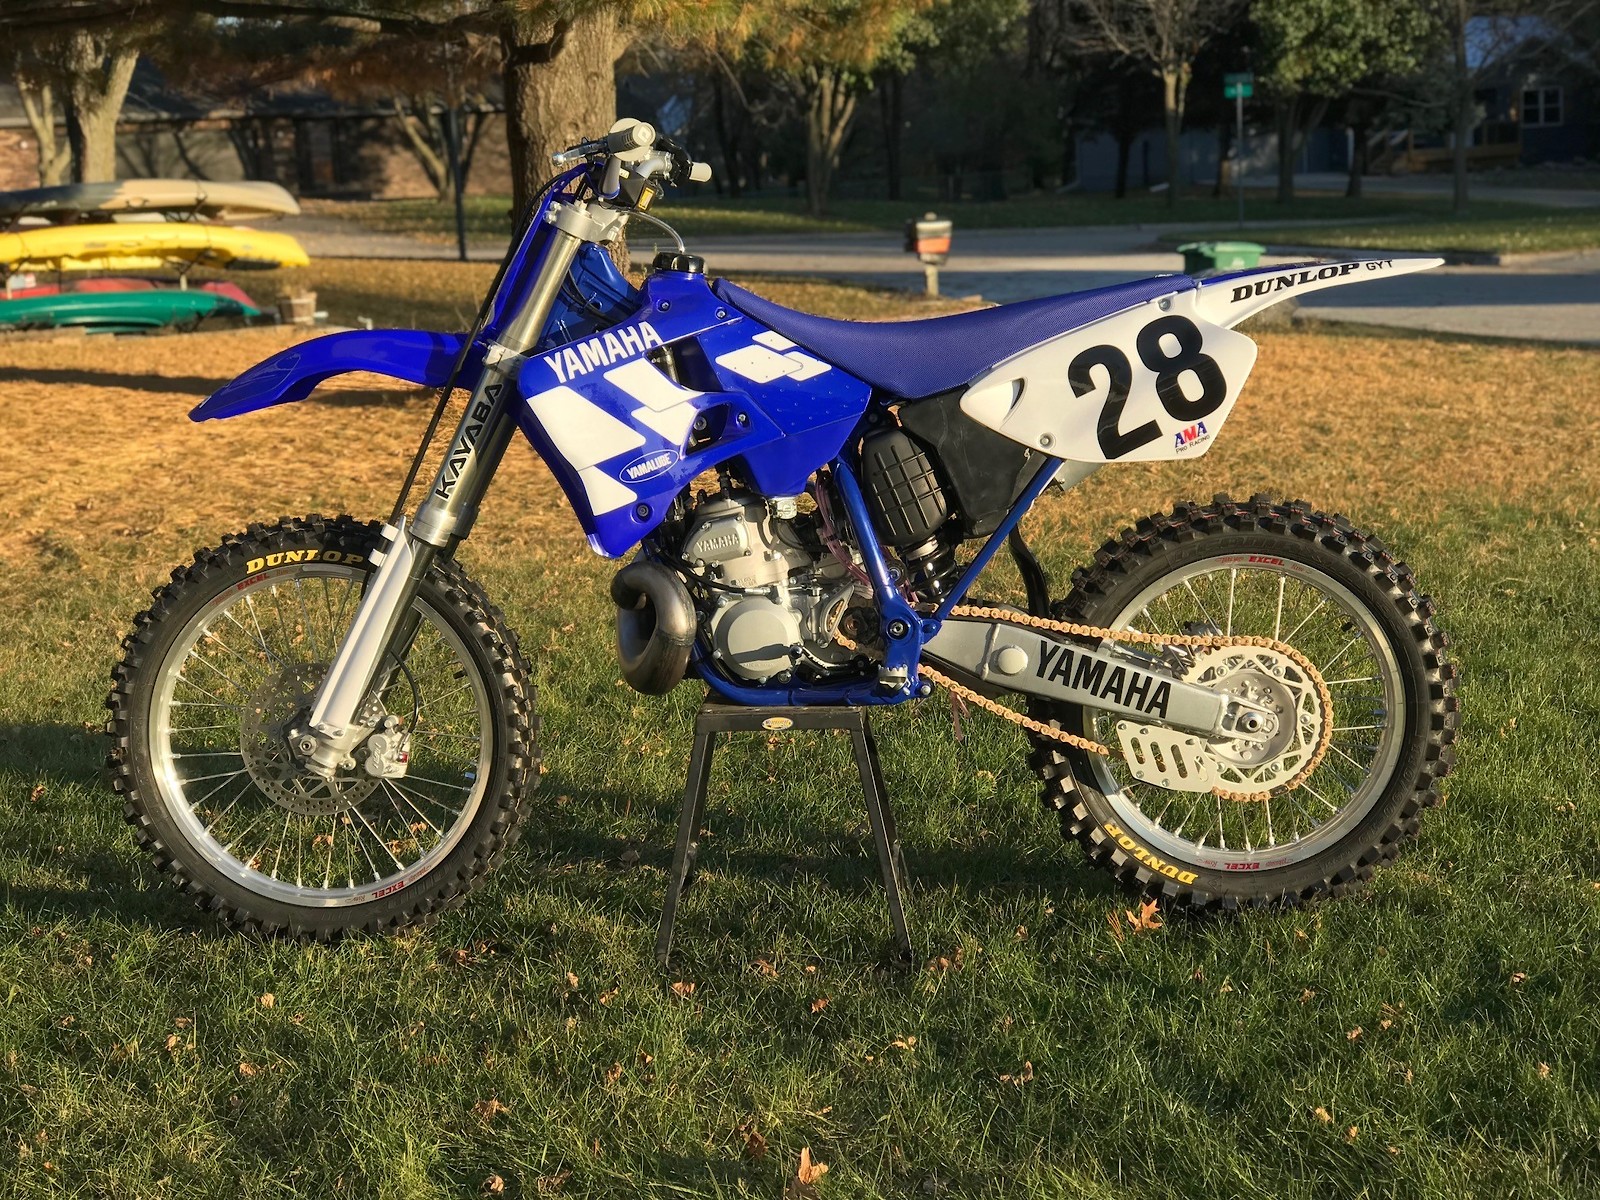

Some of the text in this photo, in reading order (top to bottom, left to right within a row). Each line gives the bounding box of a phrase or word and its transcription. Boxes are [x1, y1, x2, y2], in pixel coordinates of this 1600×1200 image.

[1231, 260, 1394, 303] DUNLOP GYT
[544, 321, 663, 384] YAMAHA
[1067, 315, 1227, 460] 28
[435, 383, 503, 500] KAYABA
[1175, 421, 1207, 448] AMA
[626, 451, 672, 480] YAMALUBE
[695, 533, 739, 553] YAMAHA
[246, 549, 364, 575] DUNLOP
[1248, 555, 1285, 567] EXCEL
[236, 572, 271, 590] EXCEL
[1035, 640, 1172, 720] YAMAHA
[1104, 822, 1199, 885] DUNLOP
[1224, 862, 1260, 870] EXCEL
[371, 880, 406, 899] EXCEL
